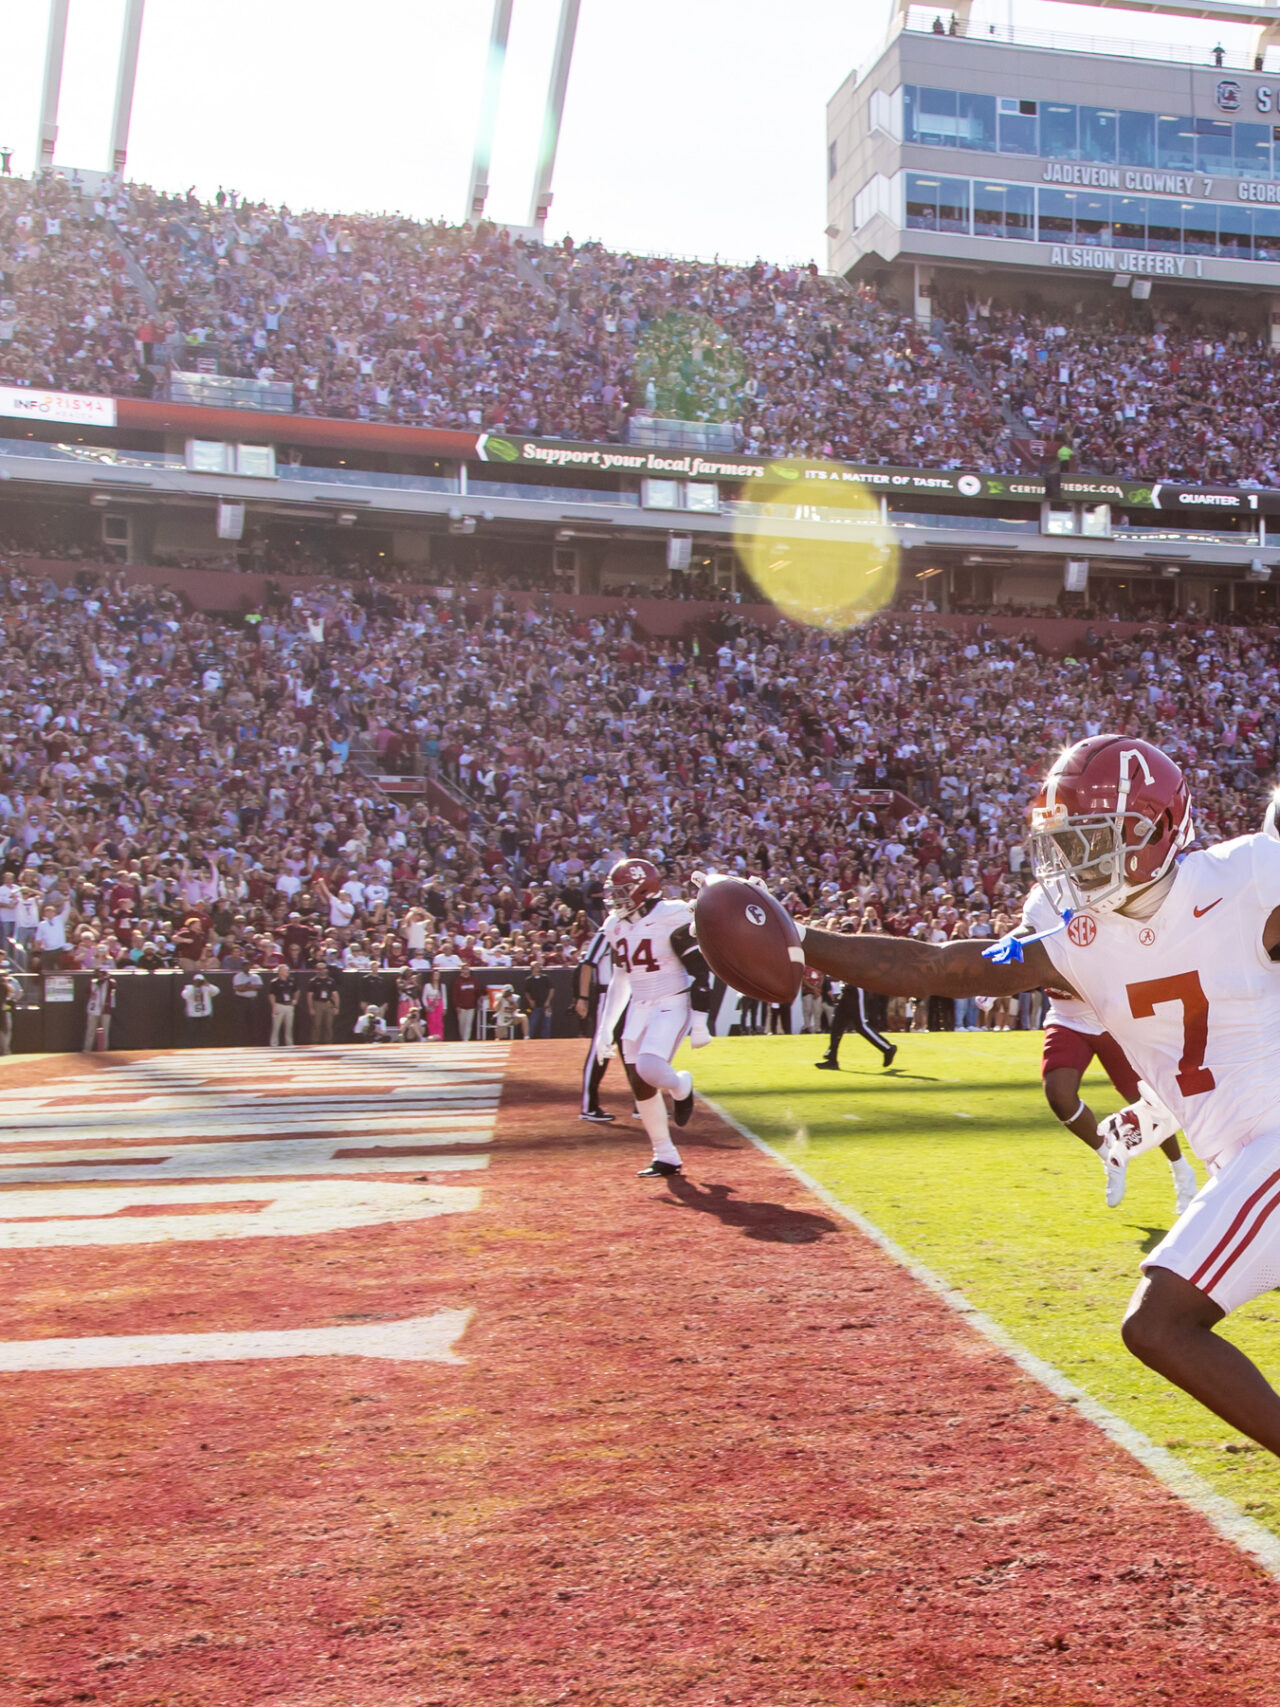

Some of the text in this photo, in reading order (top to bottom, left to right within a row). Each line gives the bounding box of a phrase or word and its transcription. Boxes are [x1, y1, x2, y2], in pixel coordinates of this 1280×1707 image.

[1043, 164, 1213, 196] JADEVEON CLOWNEY 7
[1051, 247, 1203, 277] ALSHON JEFFERY 1
[522, 443, 764, 477] Support your local farmers
[830, 472, 839, 480] A
[842, 472, 889, 484] MATTER
[892, 475, 910, 485] OF
[1179, 493, 1258, 509] QUARTER: 1
[629, 865, 646, 880] 94
[1068, 915, 1096, 946] SEC
[613, 937, 660, 973] 94
[1126, 970, 1216, 1097] 7
